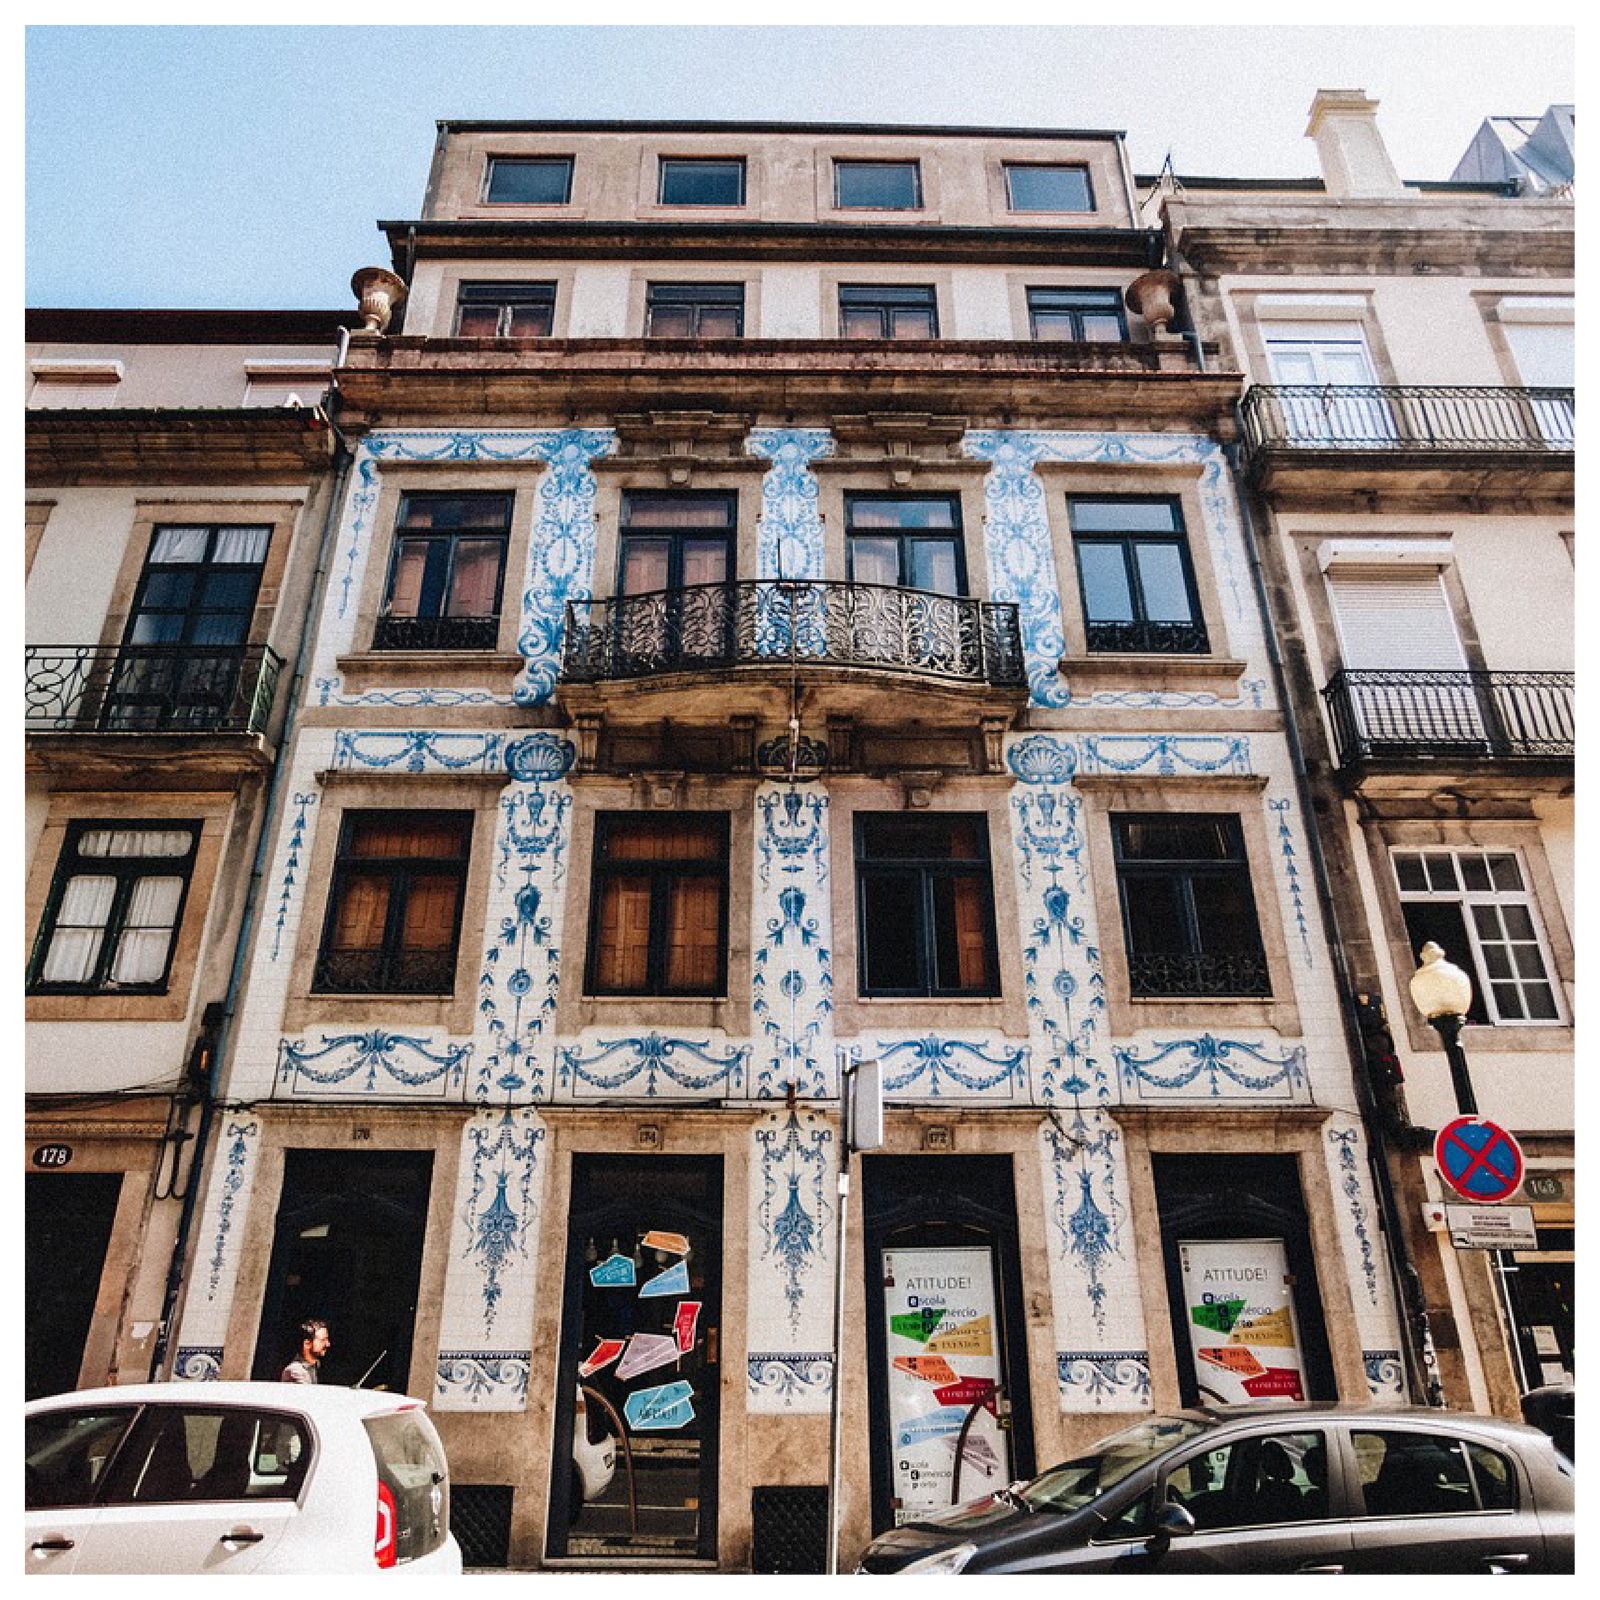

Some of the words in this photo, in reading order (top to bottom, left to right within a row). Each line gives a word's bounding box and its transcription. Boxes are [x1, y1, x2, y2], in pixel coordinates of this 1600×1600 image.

[40, 1147, 68, 1165] 178
[1203, 1267, 1268, 1282] ATITUDE!
[906, 1276, 972, 1290] ATITUDE!
